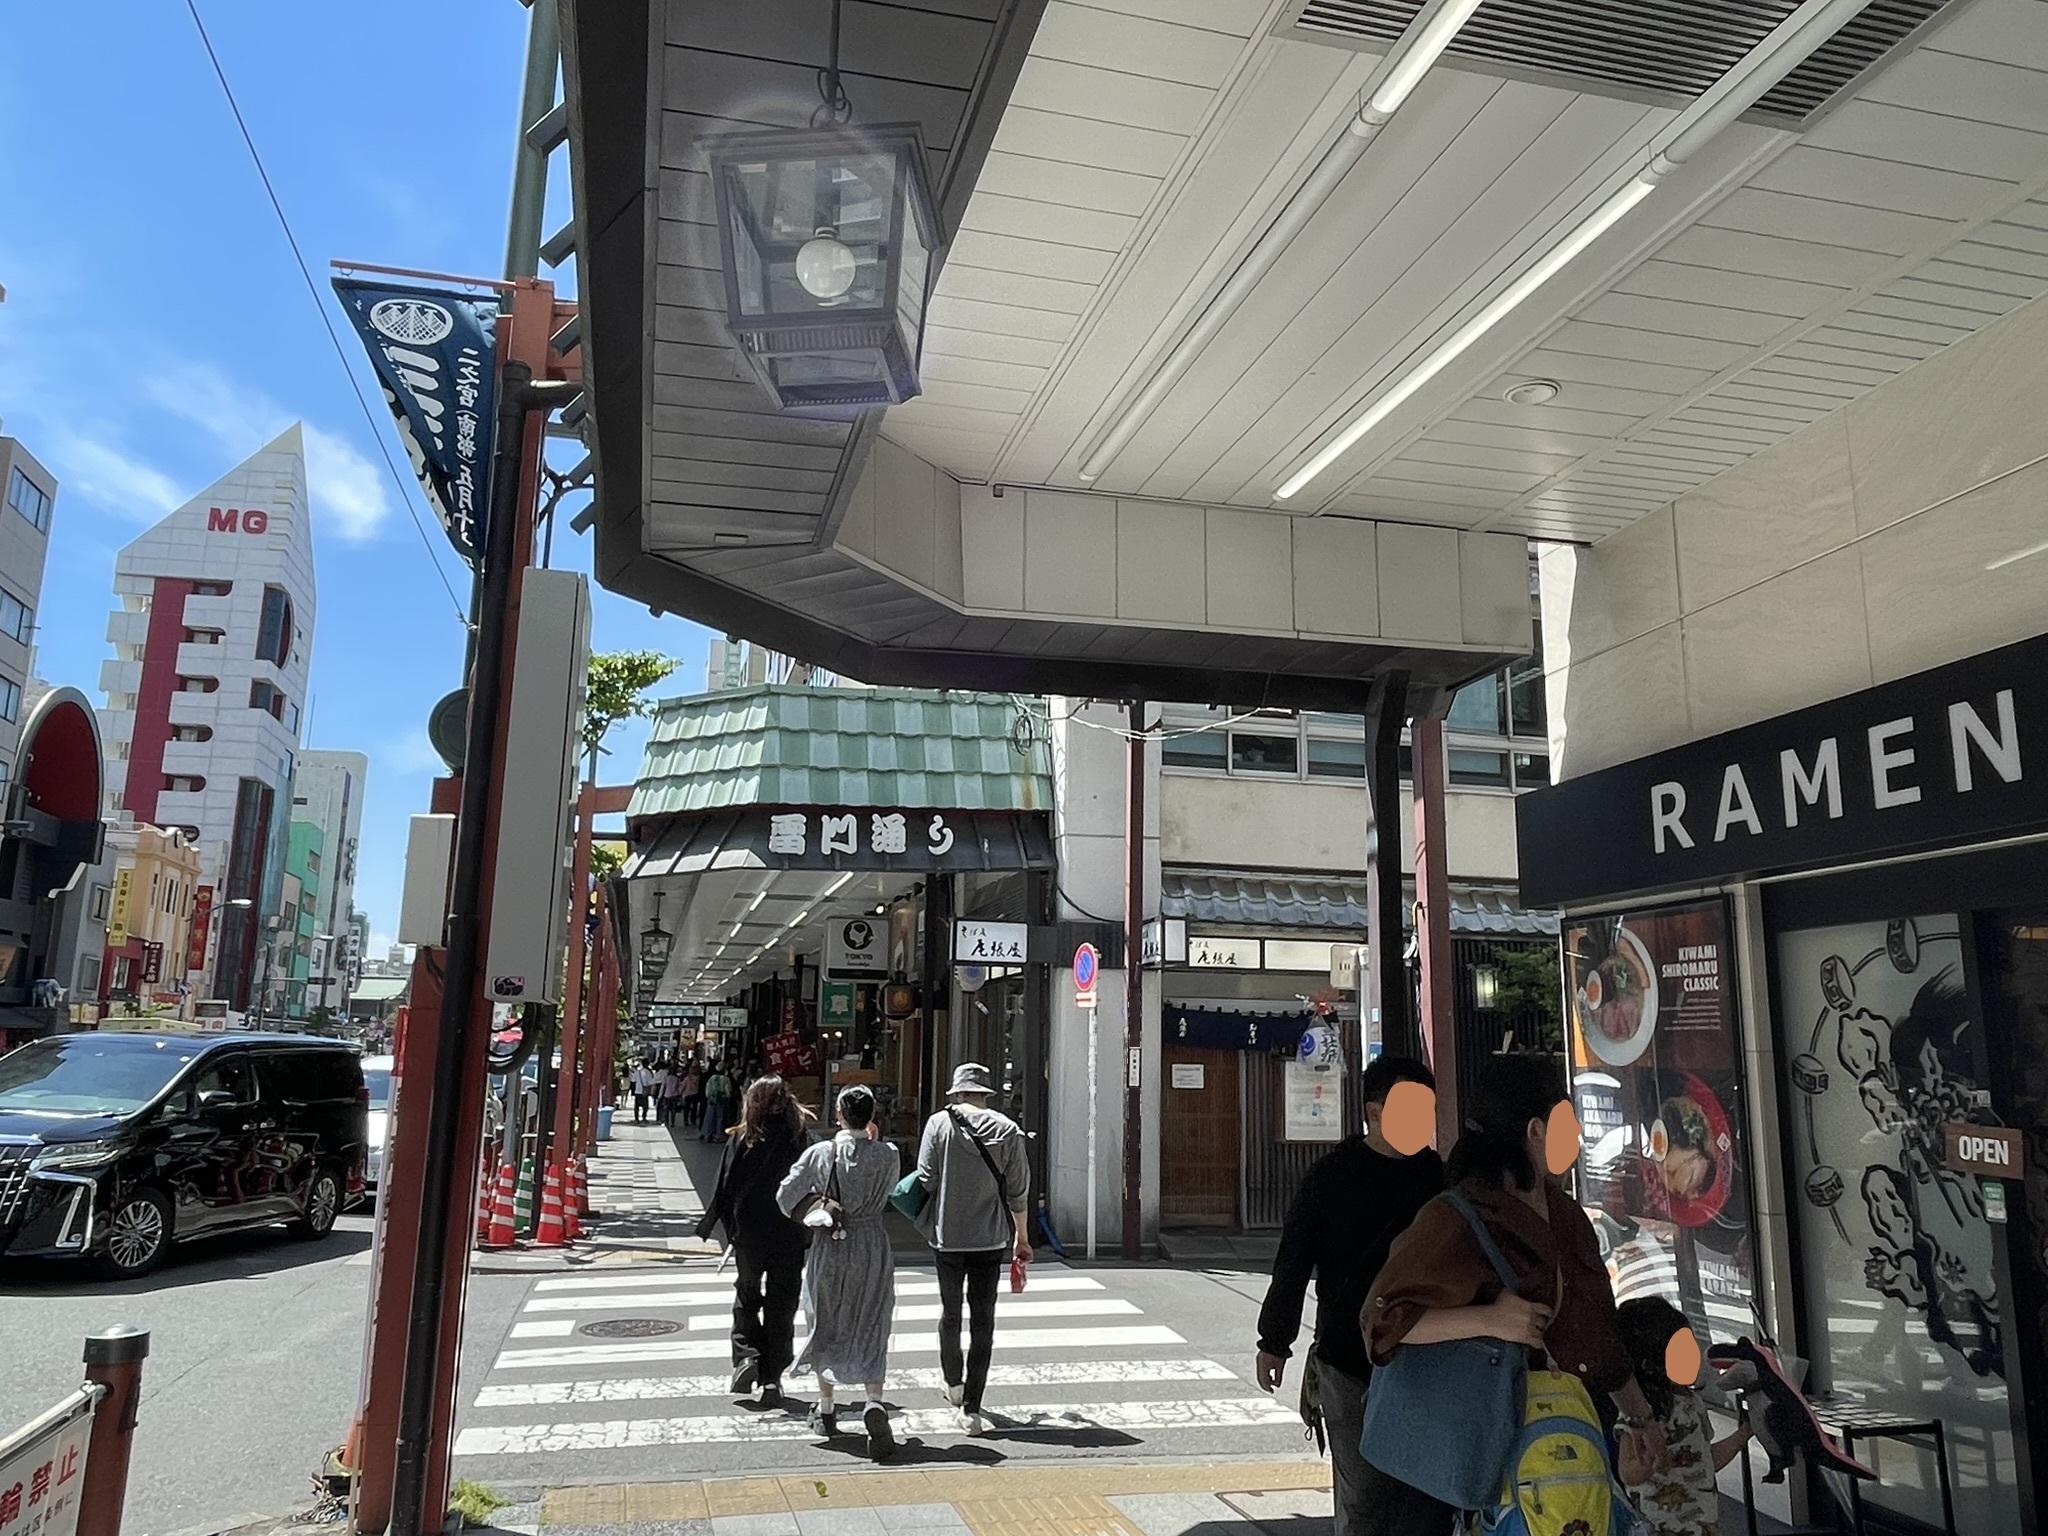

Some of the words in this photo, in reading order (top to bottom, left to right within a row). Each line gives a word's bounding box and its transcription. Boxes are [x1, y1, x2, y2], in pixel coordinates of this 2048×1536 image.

[208, 508, 268, 534] MG
[1650, 689, 2023, 854] RAMEN
[768, 813, 954, 856] 雷門通り
[1678, 945, 1717, 961] KIWAMI
[1662, 960, 1718, 978] SHIROMARU
[1683, 977, 1719, 992] CLASSIC
[1958, 1135, 2009, 1166] OPEN
